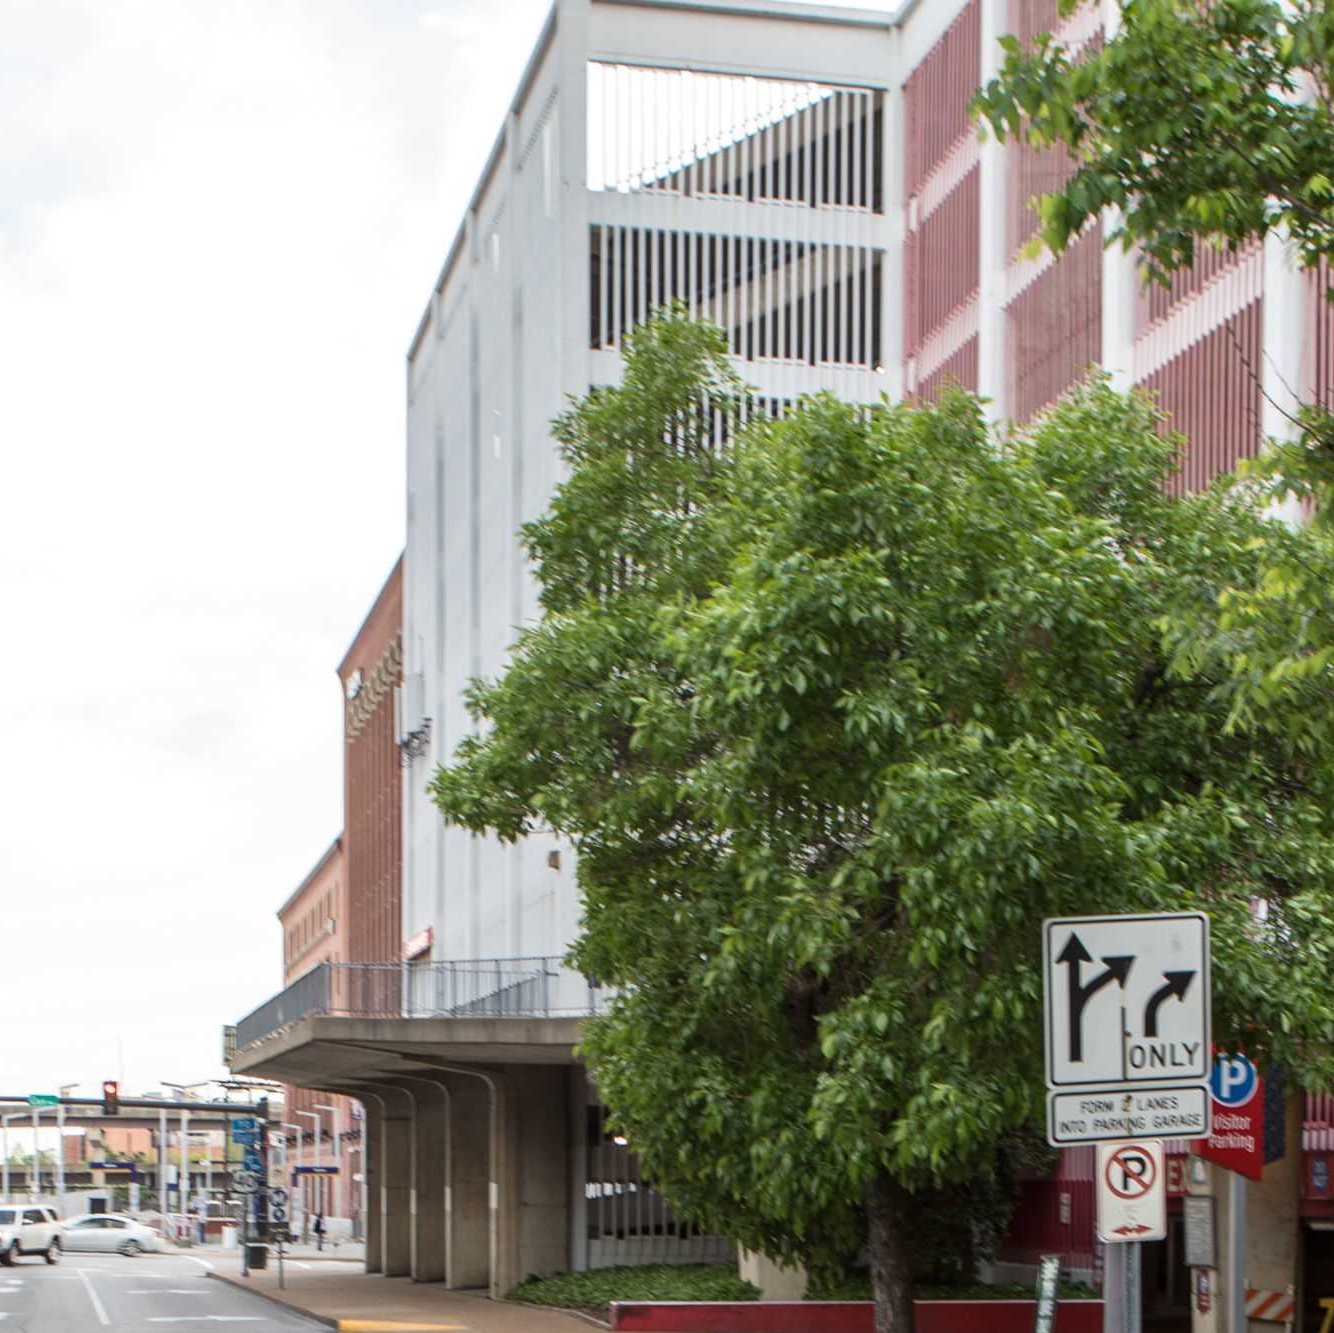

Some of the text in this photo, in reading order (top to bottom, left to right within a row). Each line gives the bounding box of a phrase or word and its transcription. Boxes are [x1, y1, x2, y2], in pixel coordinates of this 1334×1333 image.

[1131, 1042, 1200, 1069] ONLY
[1220, 1060, 1248, 1098] P
[1080, 1100, 1115, 1114] FORM
[1137, 1096, 1179, 1111] LANES
[1059, 1113, 1202, 1134] INTO PARKING GARAGE
